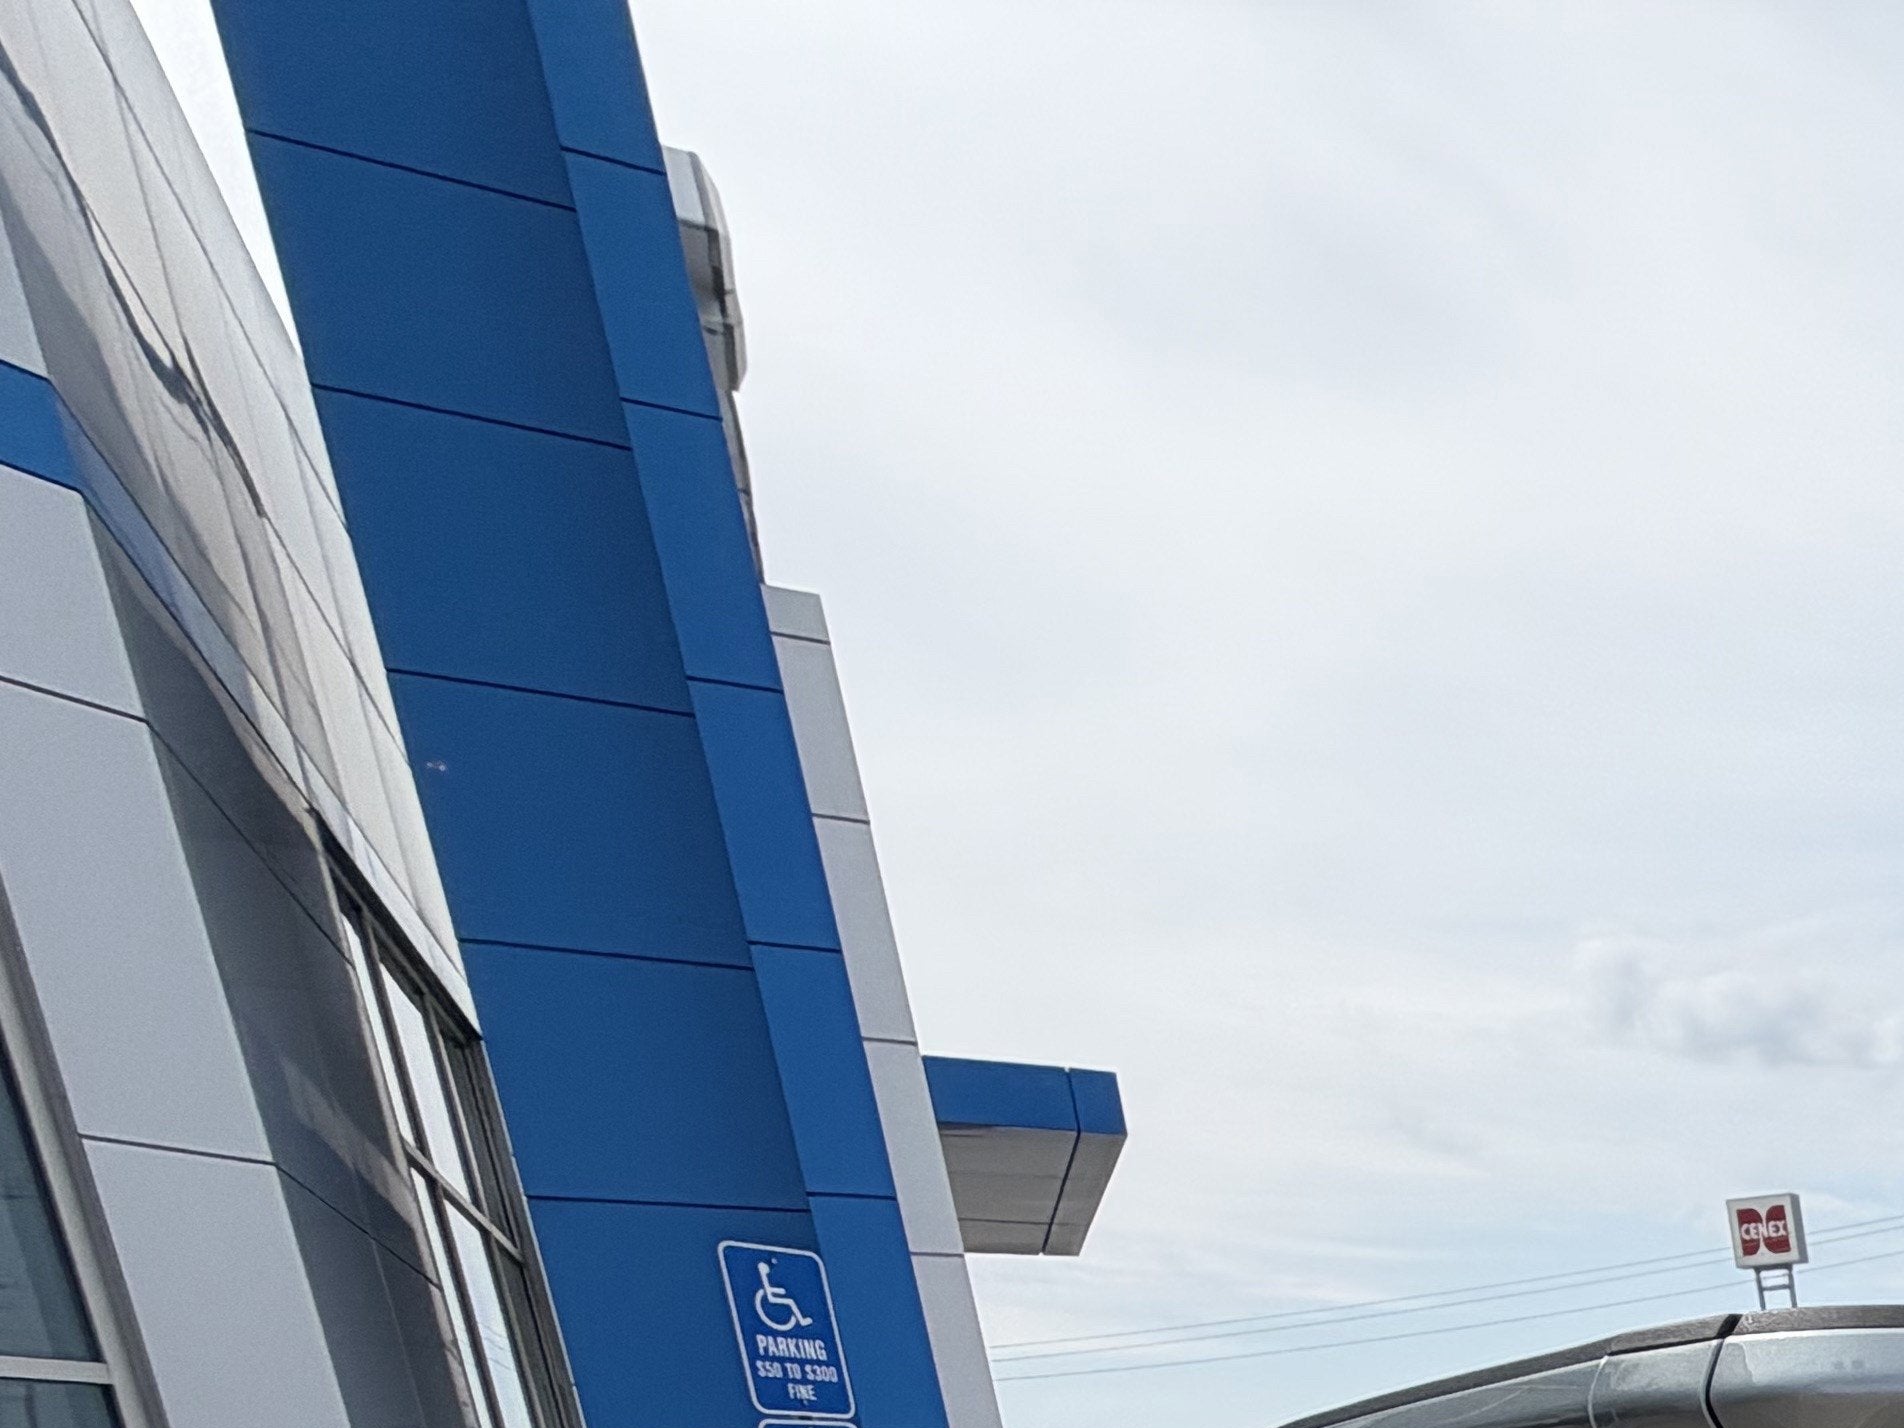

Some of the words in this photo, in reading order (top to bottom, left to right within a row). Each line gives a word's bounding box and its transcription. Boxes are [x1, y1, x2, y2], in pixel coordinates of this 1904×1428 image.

[1740, 1220, 1789, 1240] CENEX
[755, 1333, 827, 1361] PARKING
[785, 1362, 801, 1380] TO
[804, 1365, 838, 1383] $300
[787, 1383, 818, 1401] FINE
